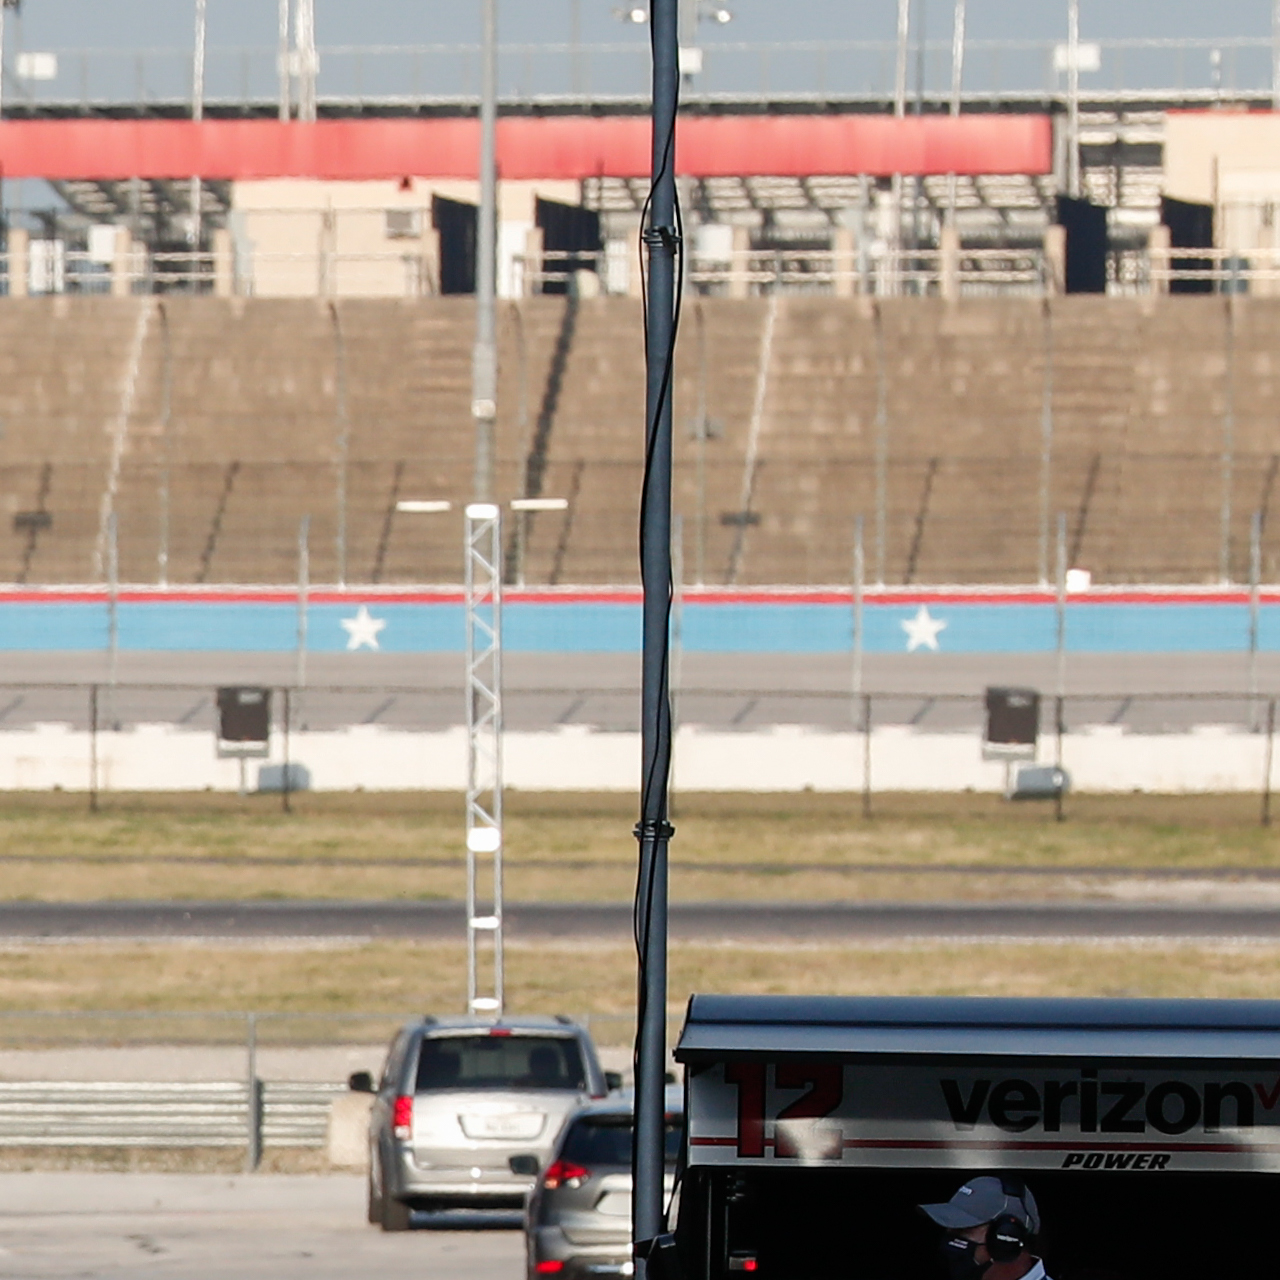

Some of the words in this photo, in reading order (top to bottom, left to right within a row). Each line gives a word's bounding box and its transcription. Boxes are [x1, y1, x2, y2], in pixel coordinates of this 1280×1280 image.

[724, 1062, 844, 1158] 12
[939, 1068, 1256, 1136] verizon
[1061, 1152, 1172, 1170] POWER
